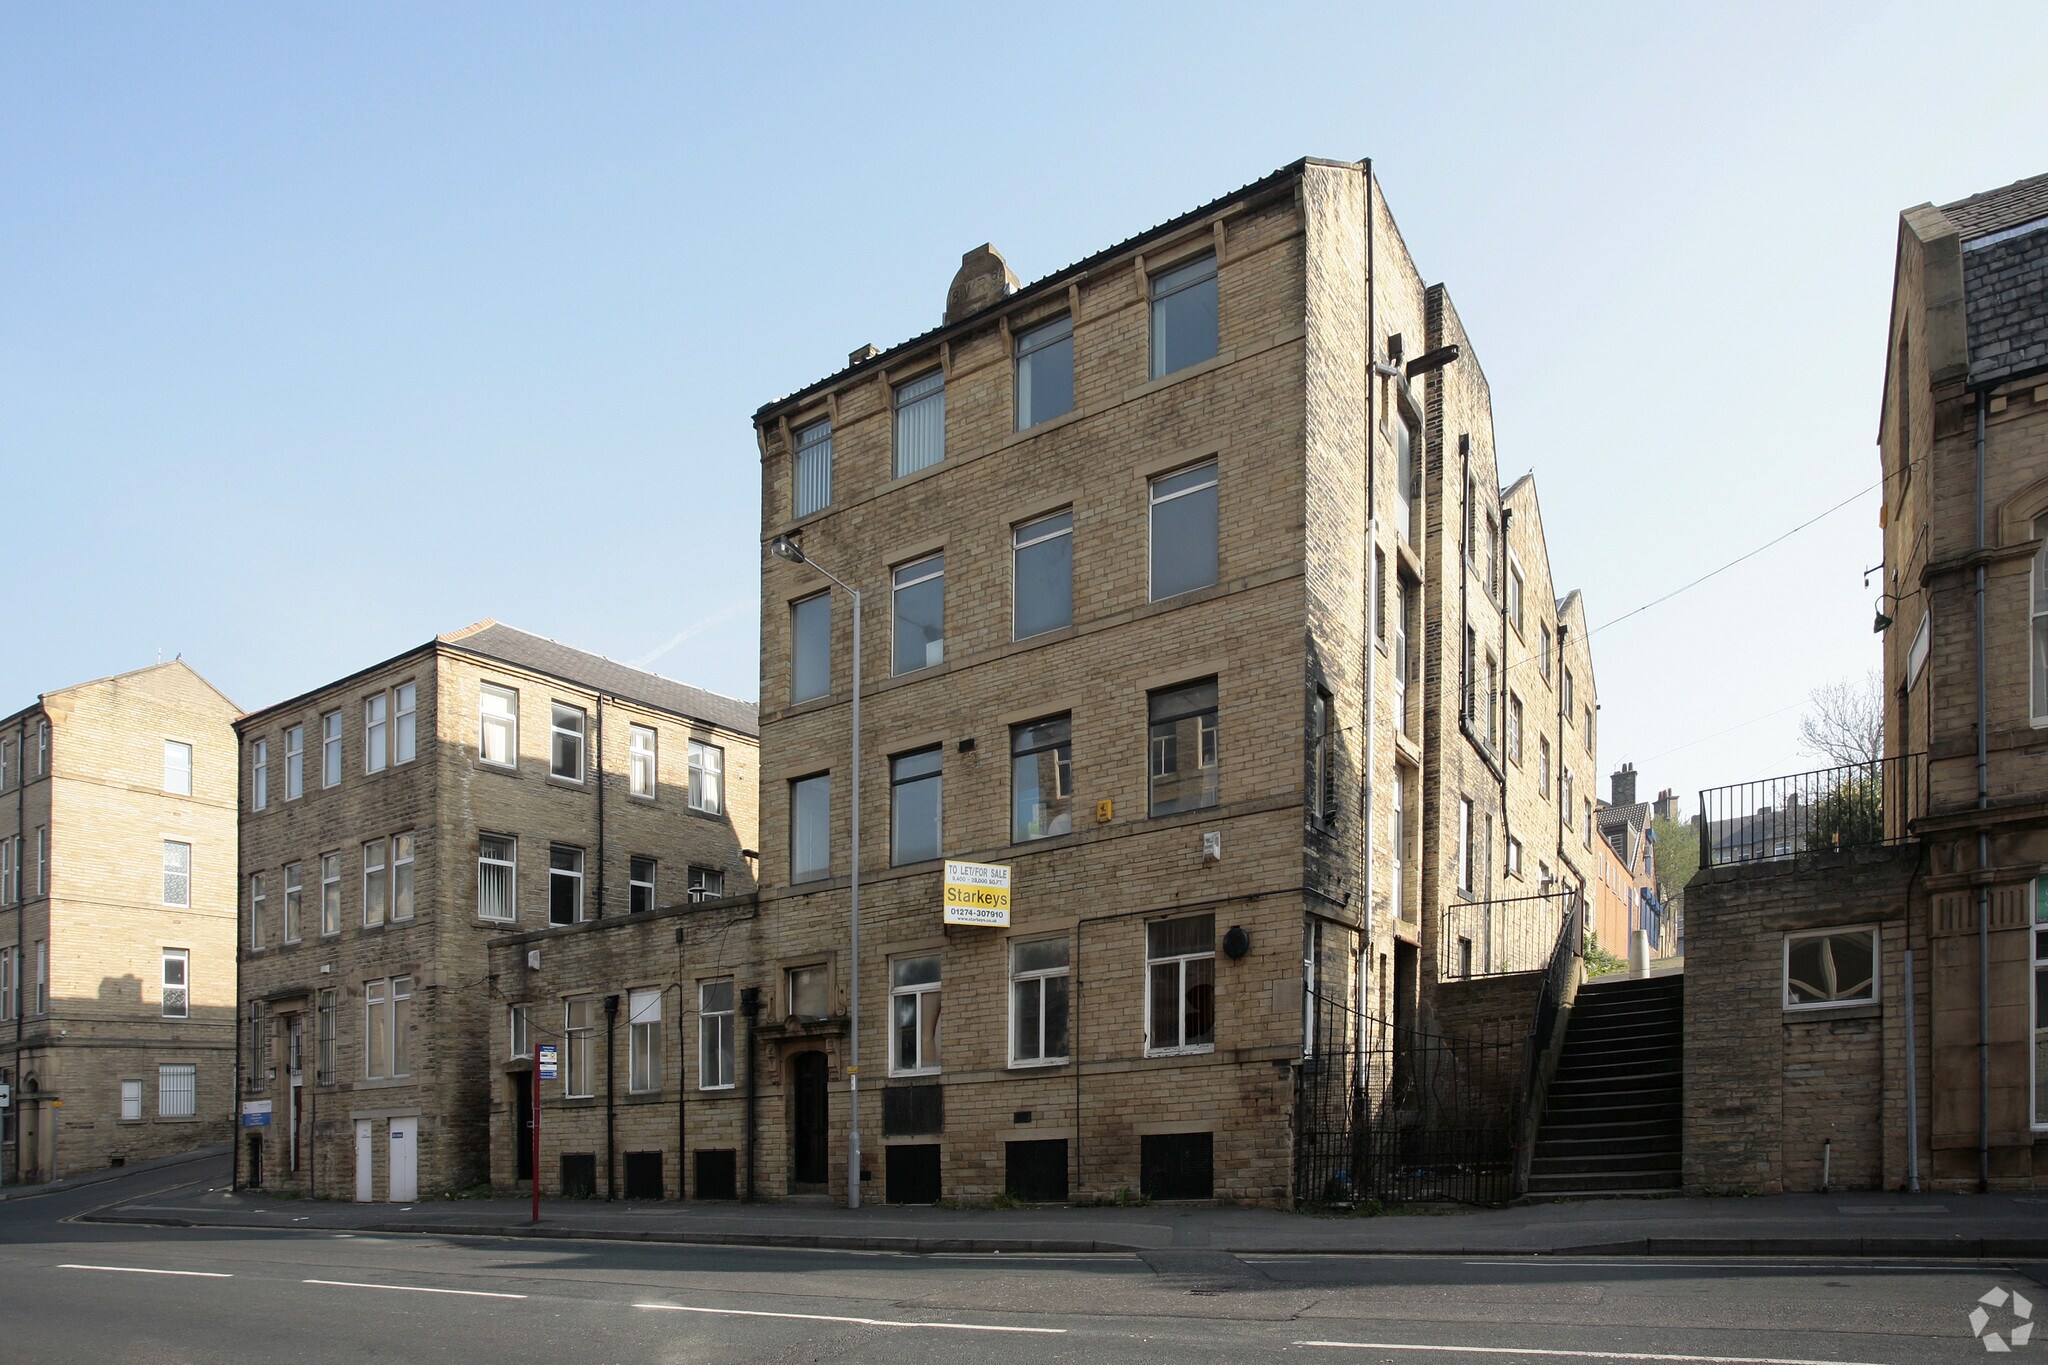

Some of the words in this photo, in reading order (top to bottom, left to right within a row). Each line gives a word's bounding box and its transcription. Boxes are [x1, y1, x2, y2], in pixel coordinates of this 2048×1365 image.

[948, 864, 958, 875] TO
[960, 866, 988, 877] LET/FOR
[990, 868, 1007, 879] SALE
[947, 887, 1008, 908] Starkeys
[950, 908, 1004, 919] 01274-307910
